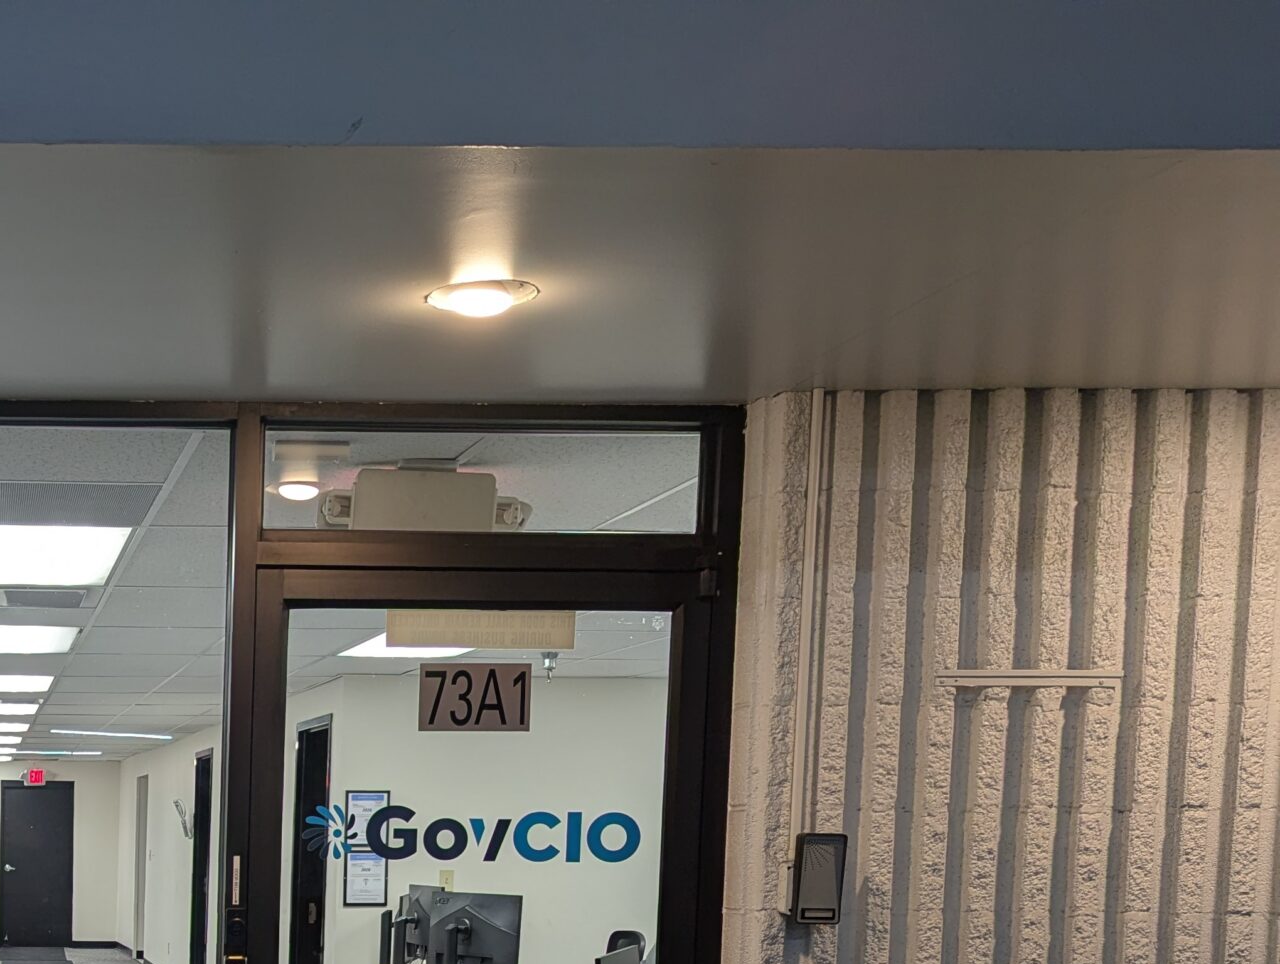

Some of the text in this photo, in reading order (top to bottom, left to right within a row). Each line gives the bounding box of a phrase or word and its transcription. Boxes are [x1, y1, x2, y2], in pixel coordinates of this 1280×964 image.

[423, 667, 529, 727] 73A1
[30, 769, 44, 784] EXIT
[365, 804, 642, 864] GovCIO
